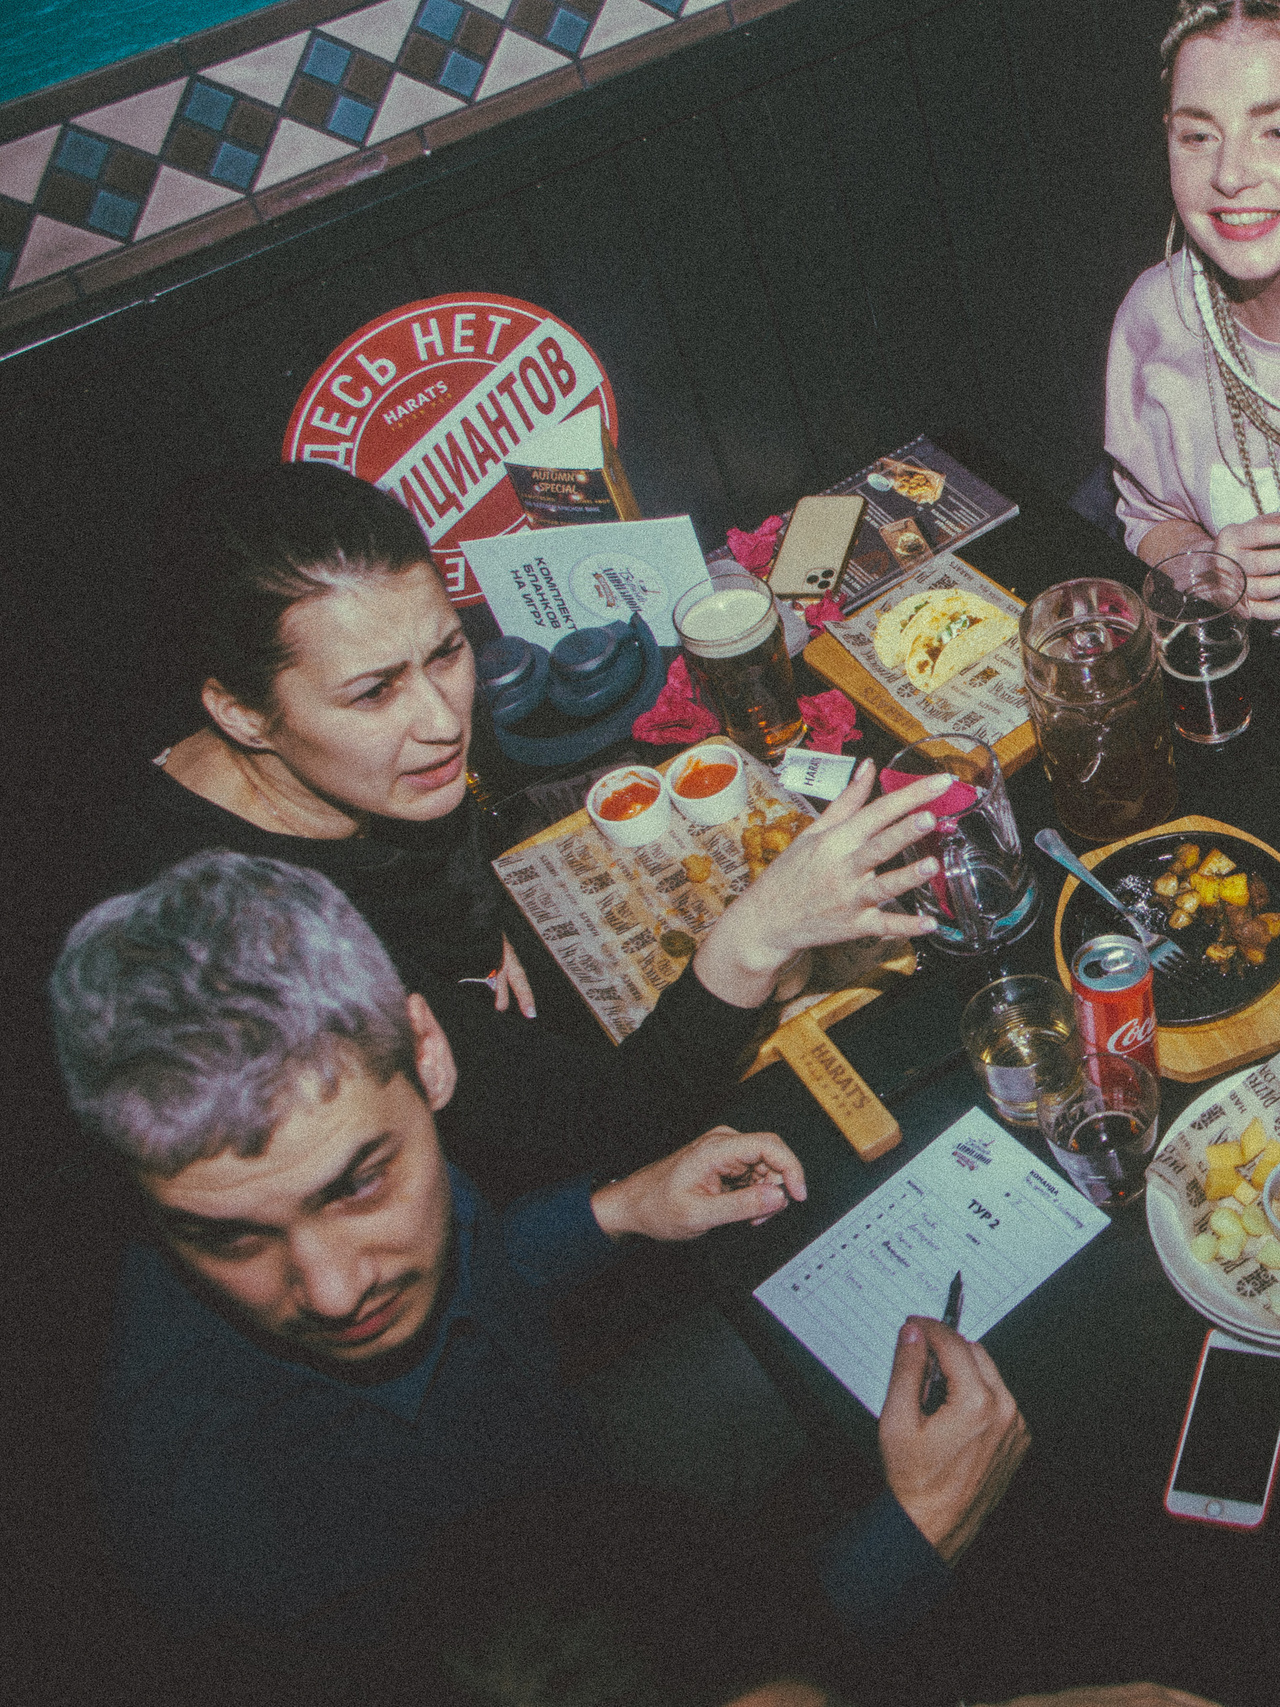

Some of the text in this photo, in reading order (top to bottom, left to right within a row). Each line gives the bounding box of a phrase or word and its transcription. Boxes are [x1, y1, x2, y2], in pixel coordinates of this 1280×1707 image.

[303, 313, 512, 470] ДЕСЬ НЕТ
[390, 336, 577, 530] ИЦИАНТОВ
[539, 482, 580, 494] SPECIAL
[510, 569, 546, 627] НА ИГРУ
[523, 563, 561, 629] БЛАНКОВ
[535, 557, 578, 631] КОМПЛЕКТ
[967, 1198, 1001, 1230] ТУР 2
